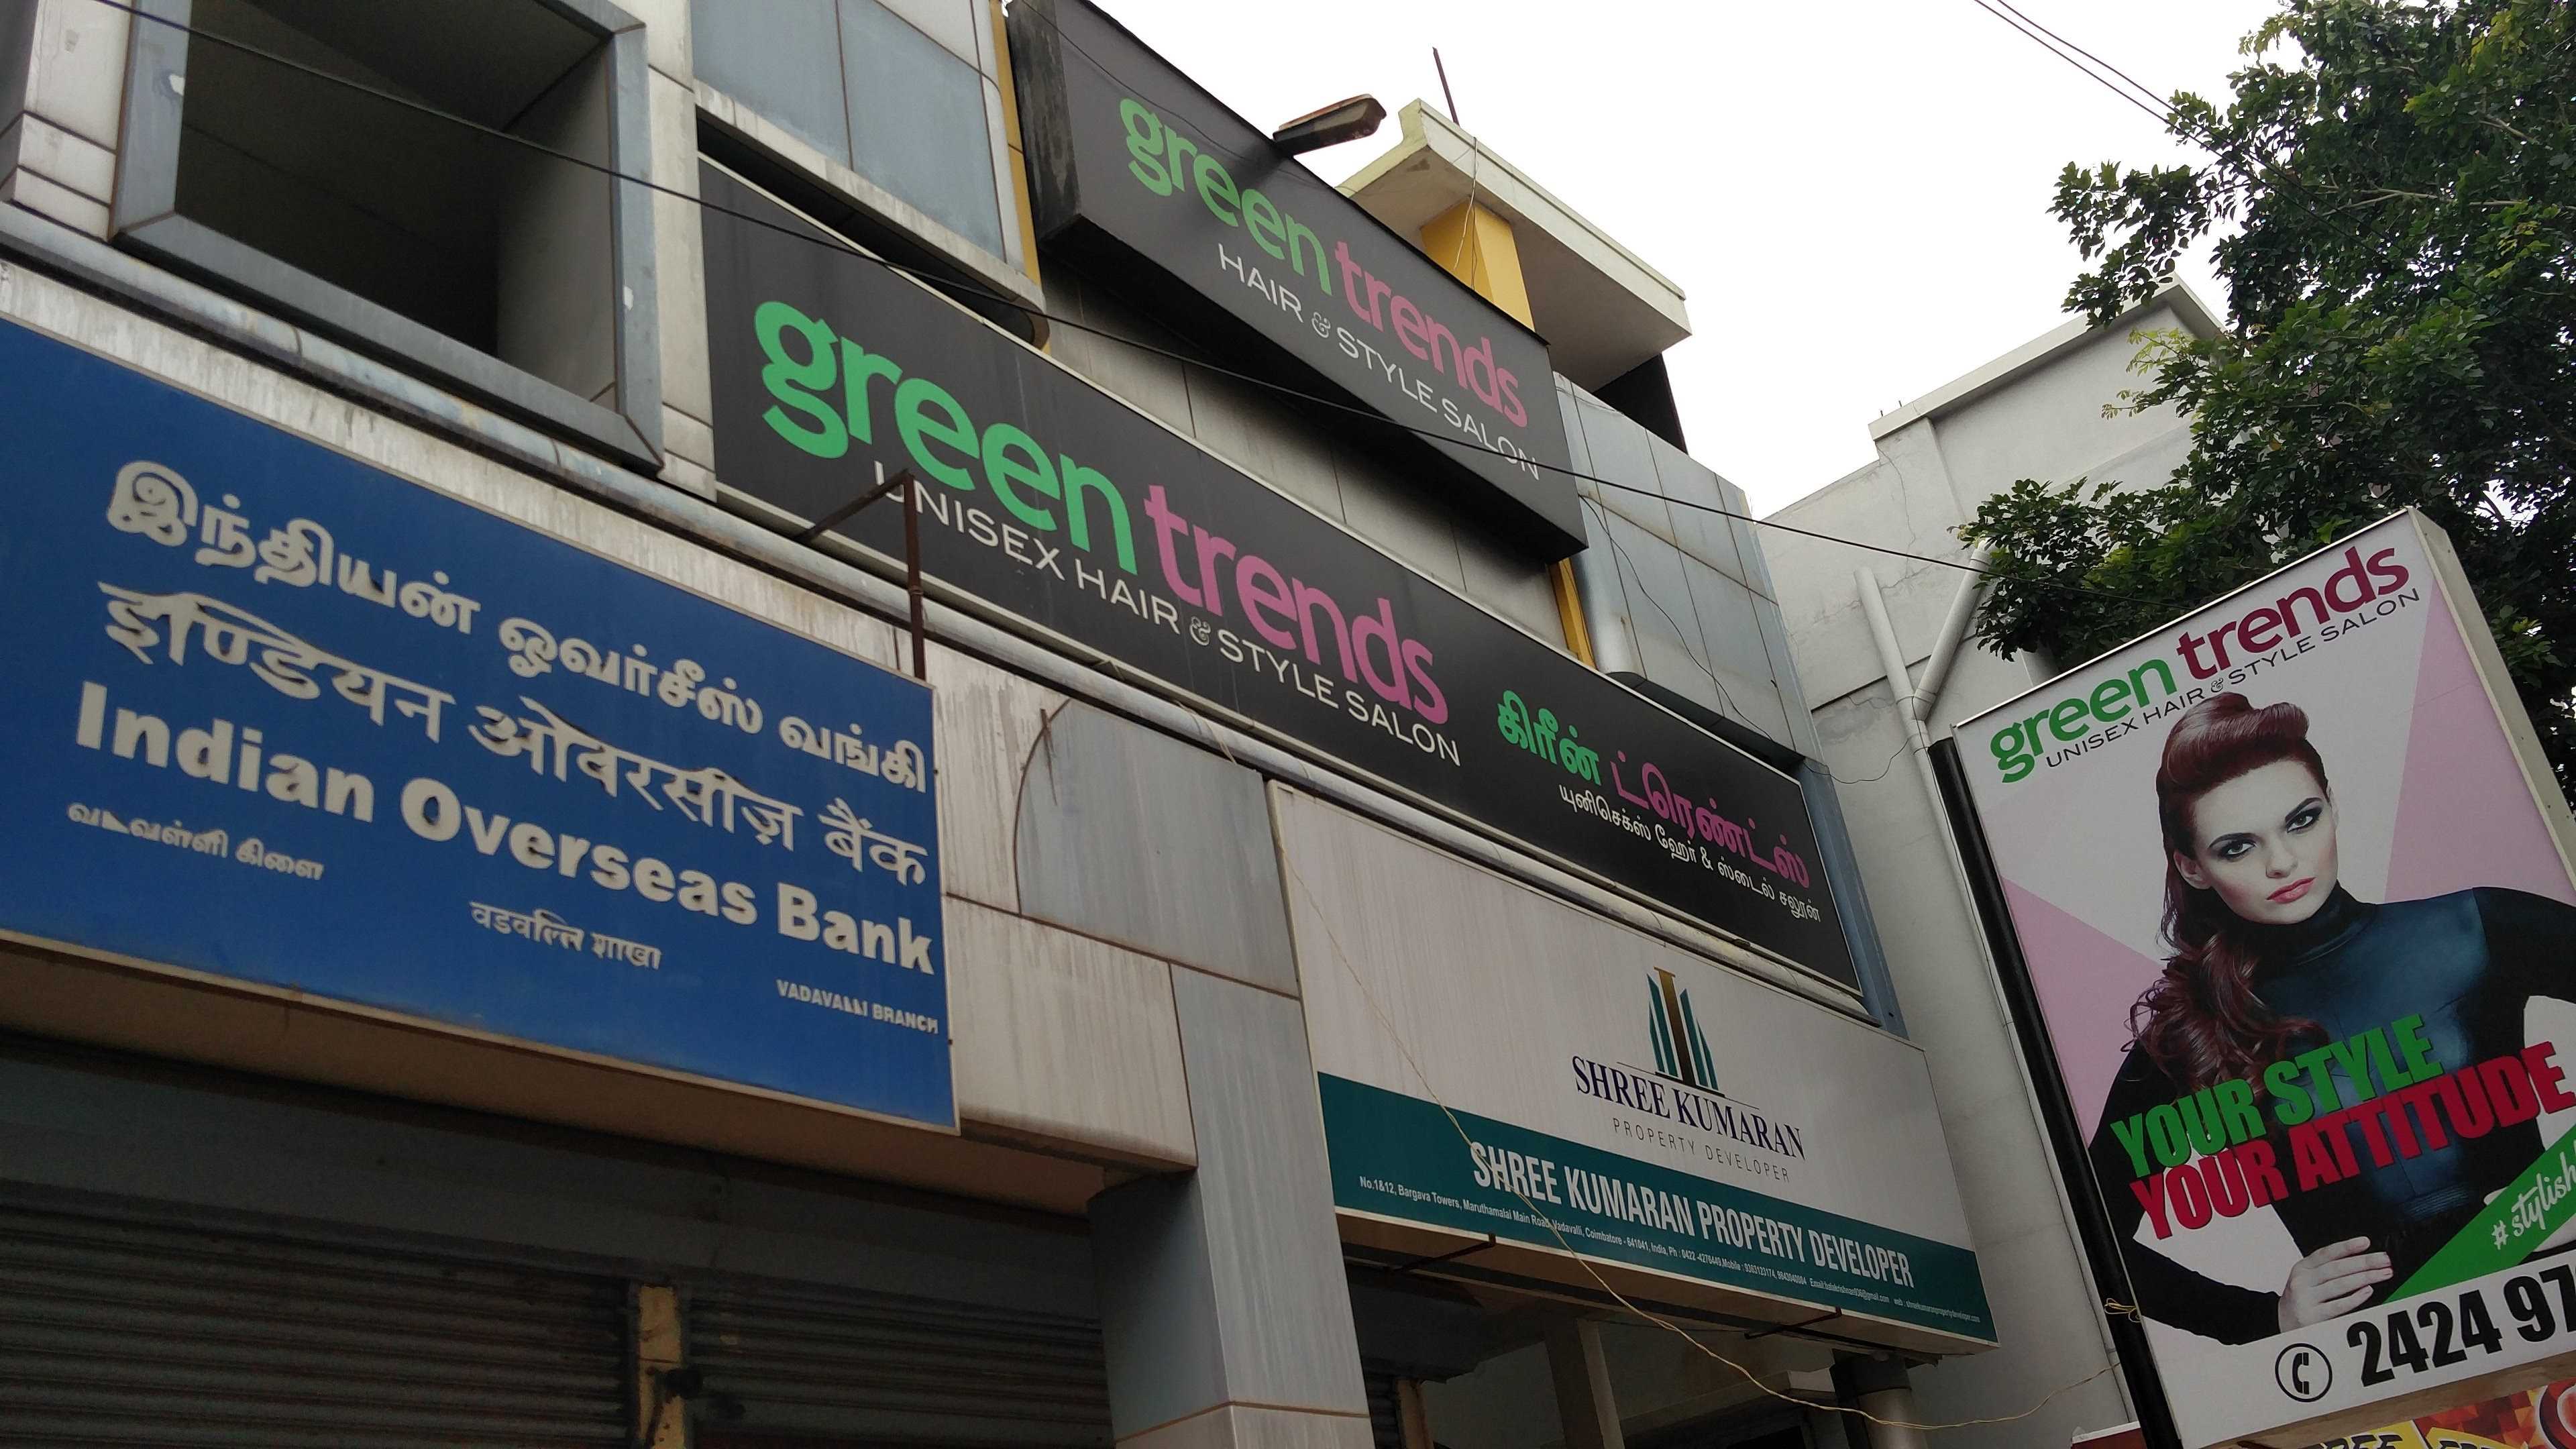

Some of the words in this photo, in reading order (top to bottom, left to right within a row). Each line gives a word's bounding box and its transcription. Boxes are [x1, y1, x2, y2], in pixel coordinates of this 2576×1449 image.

[1120, 98, 1332, 296] green
[1335, 241, 1527, 427] trends
[1218, 243, 1304, 323] HAIR
[1311, 312, 1330, 338] &
[1336, 327, 1438, 413] STYLE
[1442, 398, 1540, 480] SALON
[755, 301, 1137, 575] green
[1143, 485, 1448, 724] trends
[106, 460, 480, 635] இந்தியன்
[779, 716, 926, 793] வங்கி
[874, 460, 1065, 581] UNISEX
[1077, 558, 1180, 635] HAIR
[1189, 616, 1212, 646] &
[1218, 629, 1338, 708] STYLE
[1346, 691, 1460, 766] SALON
[1990, 657, 2178, 784] green
[2176, 546, 2409, 681] trends
[2046, 721, 2139, 769] UNISEX
[2145, 687, 2206, 725] HAIR
[2210, 678, 2224, 693] &
[2229, 636, 2316, 686] STYLE
[2321, 587, 2420, 642] SALON
[1497, 690, 1602, 786] கிரீன்
[75, 681, 375, 823] Indian
[400, 777, 758, 926] Overseas
[777, 881, 935, 975] Bank
[818, 798, 928, 885] बैंक
[1700, 847, 1713, 871] &
[776, 979, 868, 1017] VADAVALLI
[872, 1002, 938, 1034] BRANCH
[1571, 1056, 1671, 1120] SHREE
[1673, 1088, 1806, 1161] KUMARAN
[1613, 1118, 1695, 1154] PROPERTY
[1705, 1144, 1790, 1183] DEVELOPER
[2110, 1078, 2267, 1178] YOUR
[2263, 1014, 2444, 1126] STYLE
[2130, 1139, 2289, 1240] YOUR
[2287, 1041, 2575, 1191] ATTITUDE
[1398, 1184, 1431, 1201] Bargava
[1432, 1192, 1462, 1210] Towers,
[1463, 1199, 1511, 1220] Maruthamalai
[1513, 1212, 1530, 1224] Main
[1585, 1227, 1623, 1245] Coimbatore
[1470, 1141, 1561, 1205] SHREE
[1564, 1166, 1695, 1237] KUMARAN
[1697, 1201, 1805, 1263] PROPERTY
[1808, 1230, 1915, 1289] DEVELOPER
[2347, 1289, 2502, 1387] 2424
[2503, 1264, 2576, 1342] 97
